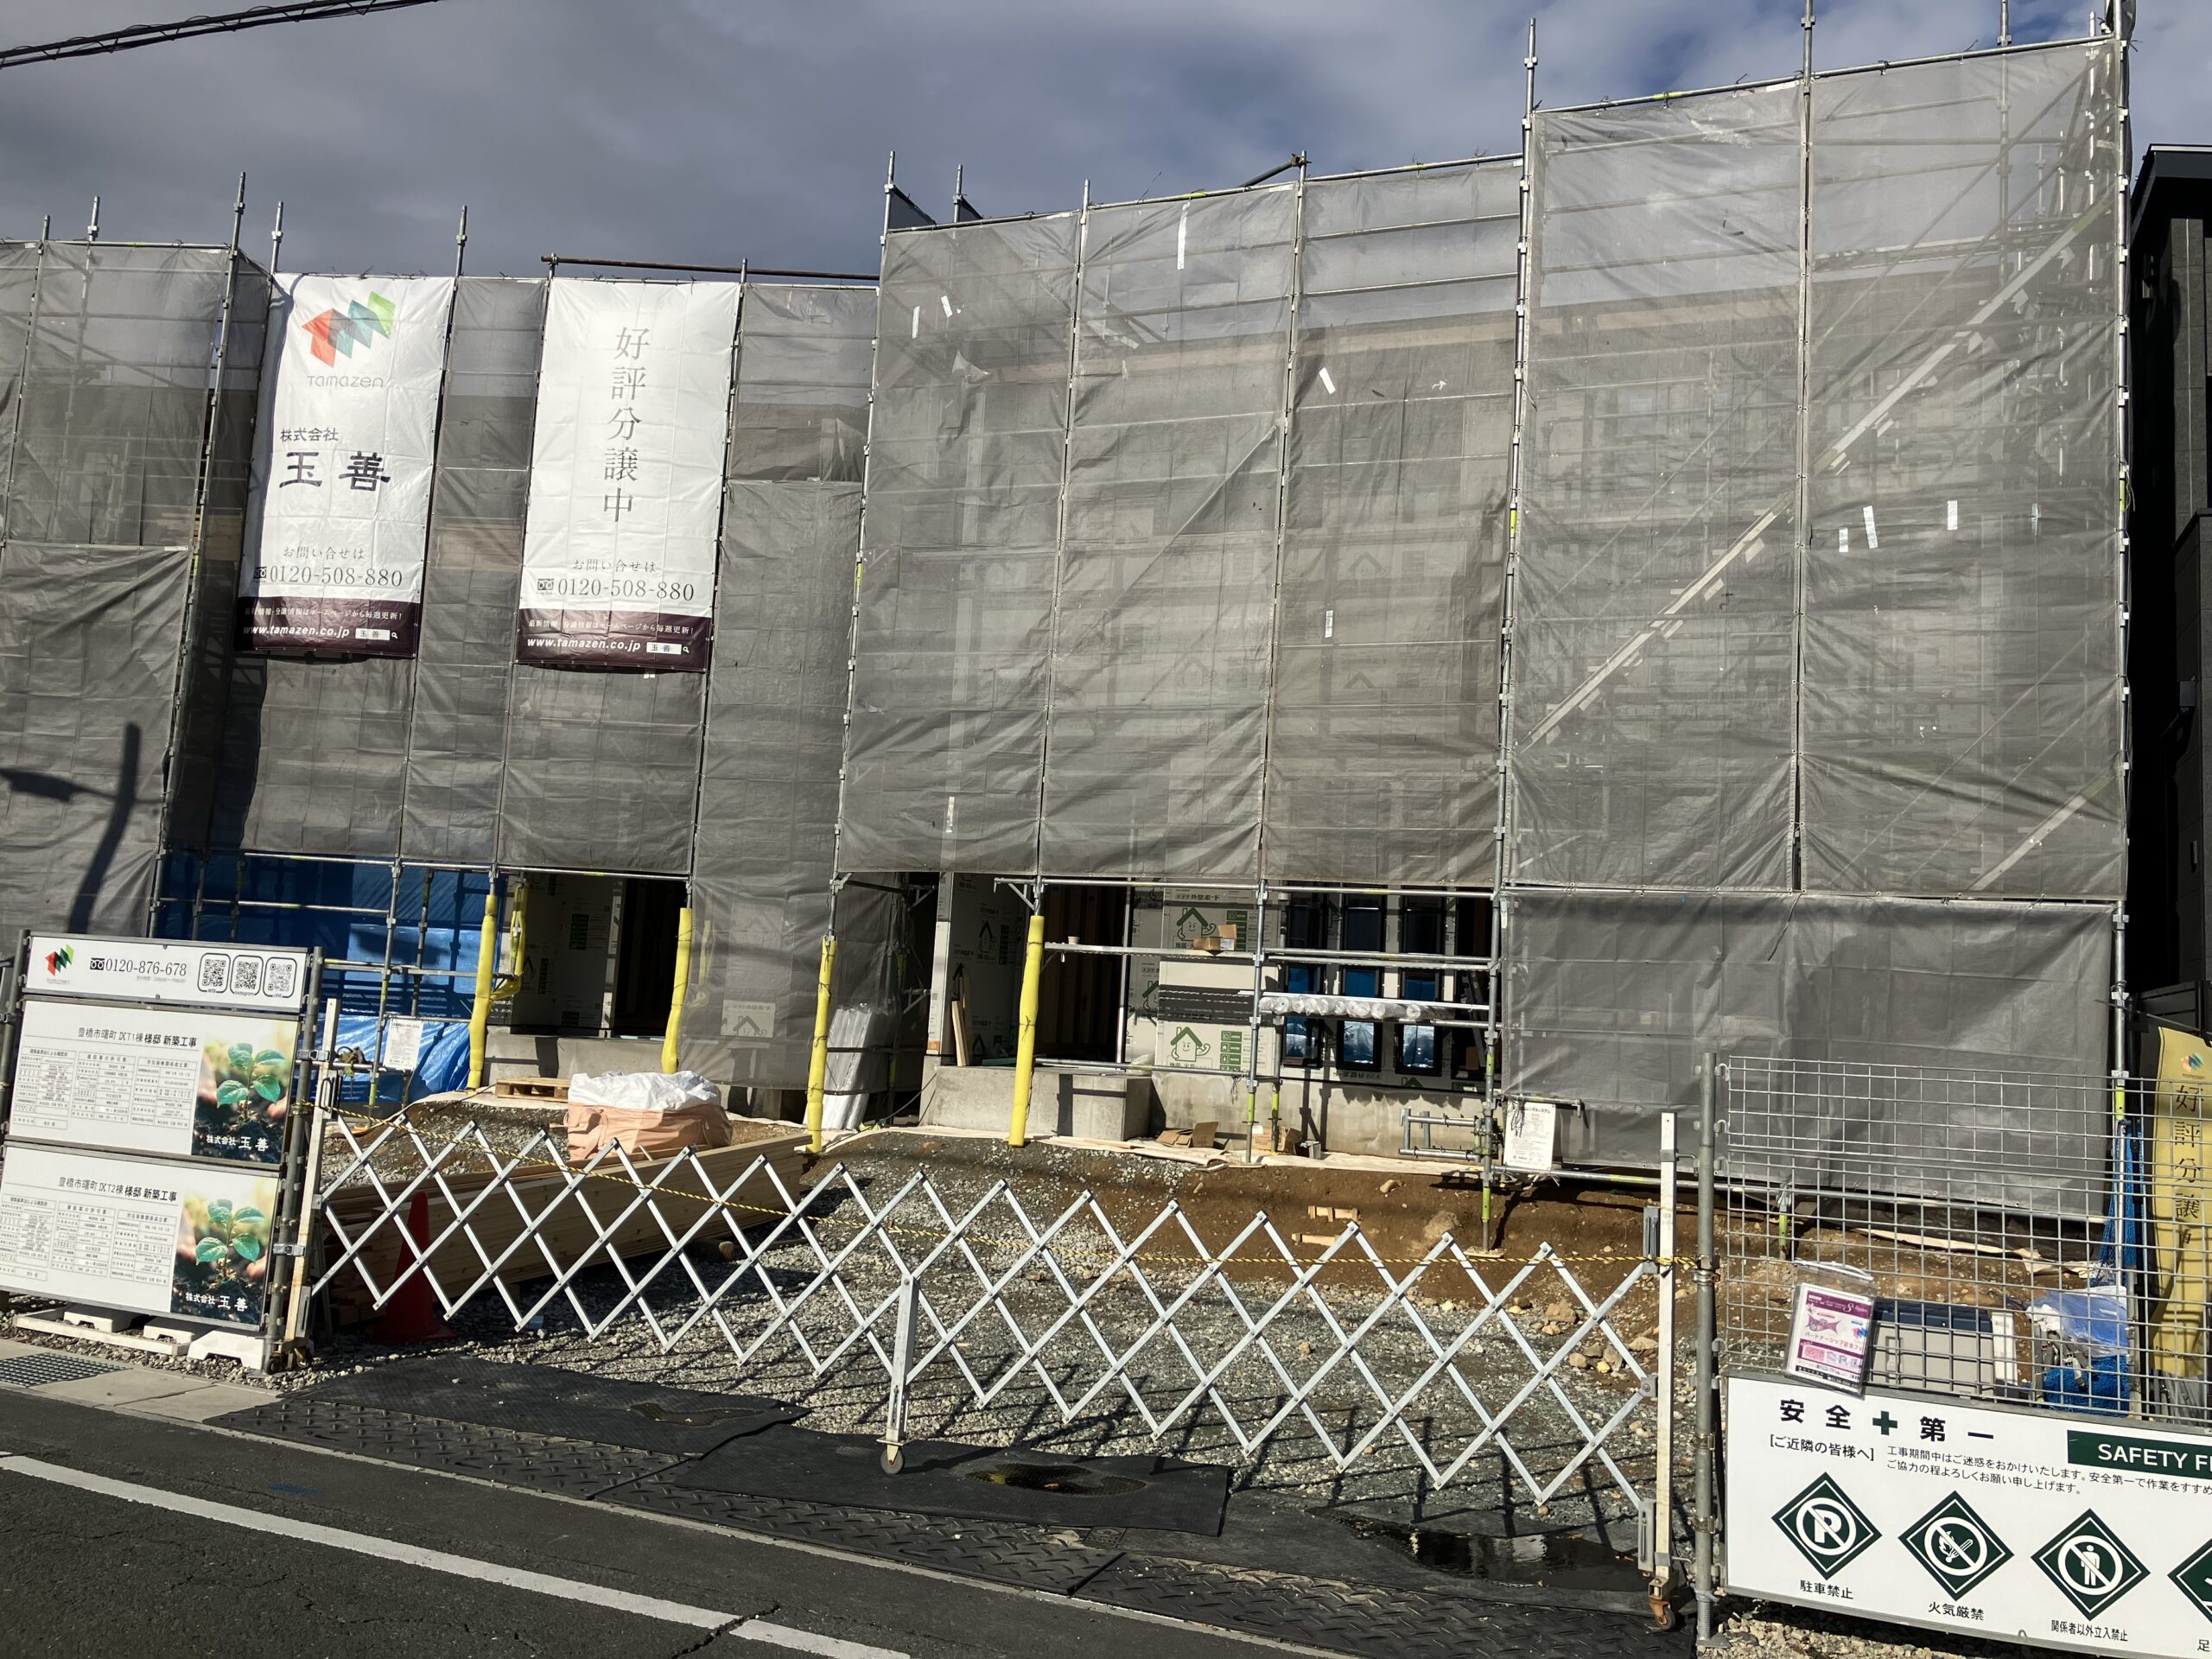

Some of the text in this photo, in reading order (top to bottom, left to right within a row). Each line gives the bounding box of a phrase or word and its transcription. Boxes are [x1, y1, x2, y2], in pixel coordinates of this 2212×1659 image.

[280, 427, 339, 442] 株式会社
[603, 326, 651, 523] 好評分譲中
[283, 546, 365, 560] お問い合せは
[270, 565, 403, 588] 0120-508-880
[573, 559, 656, 573] お問い合せは
[557, 577, 695, 601] 0120-508-880
[526, 637, 641, 652] www.tamazen.co.jp
[105, 957, 188, 977] 0120-876-678
[1770, 1433, 1875, 1462] [ご近隣の皆様へ]
[2097, 1443, 2189, 1470] SAFETY
[1887, 1459, 2081, 1495] ご協力の程よろしくお願い申し上げます。
[1800, 1580, 1854, 1600] 駐車禁止
[1928, 1601, 1985, 1621] 火気厳禁
[2050, 1619, 2128, 1643] 関係者以外立入禁止
